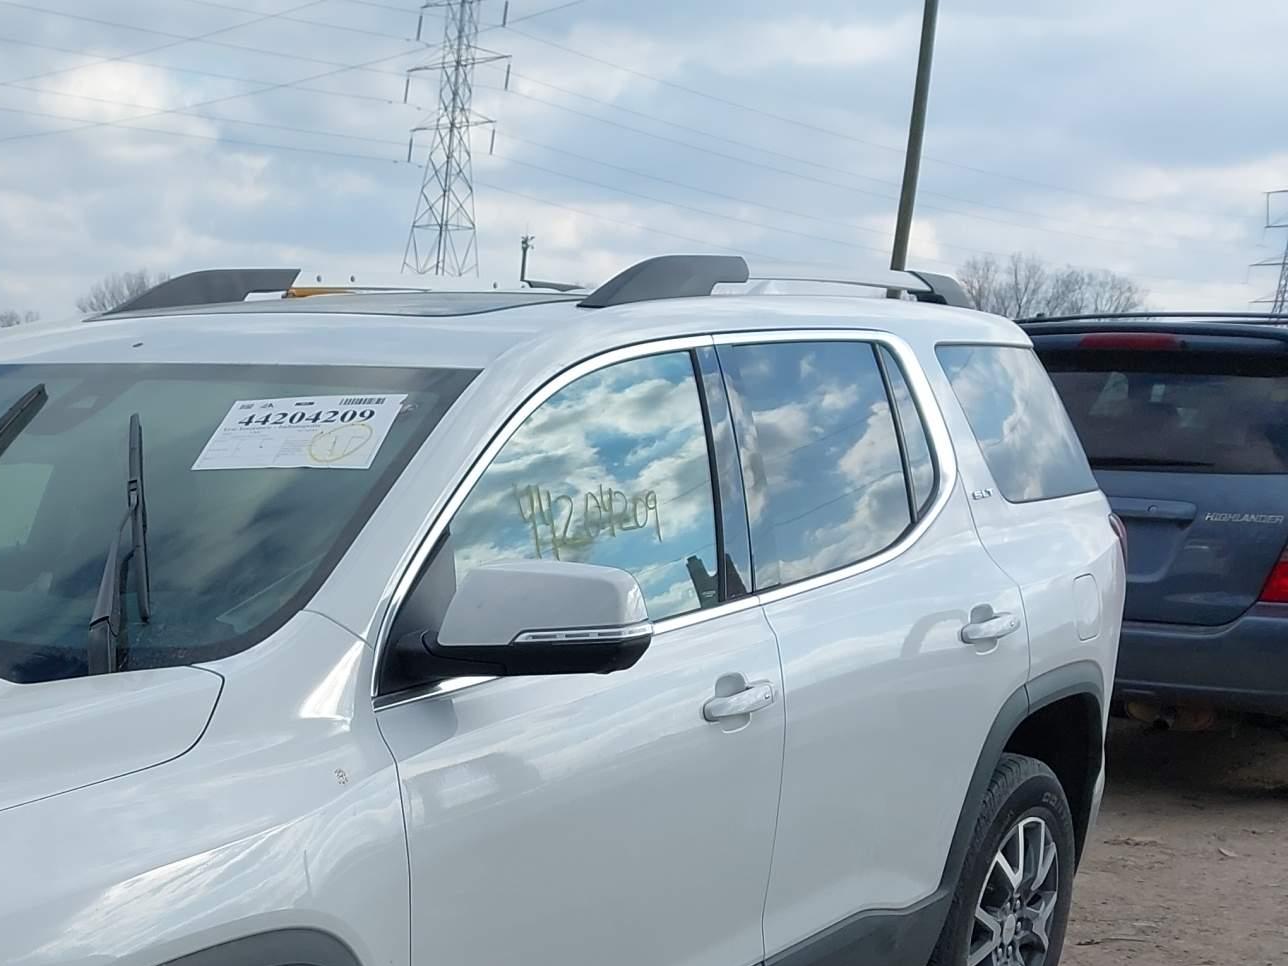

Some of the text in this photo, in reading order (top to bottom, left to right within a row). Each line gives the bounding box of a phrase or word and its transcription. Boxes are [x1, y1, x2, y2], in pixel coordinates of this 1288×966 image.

[237, 409, 376, 427] 44204209
[972, 488, 993, 500] SLT
[518, 484, 662, 560] 44204209
[1205, 512, 1285, 524] HIGHLANDER
